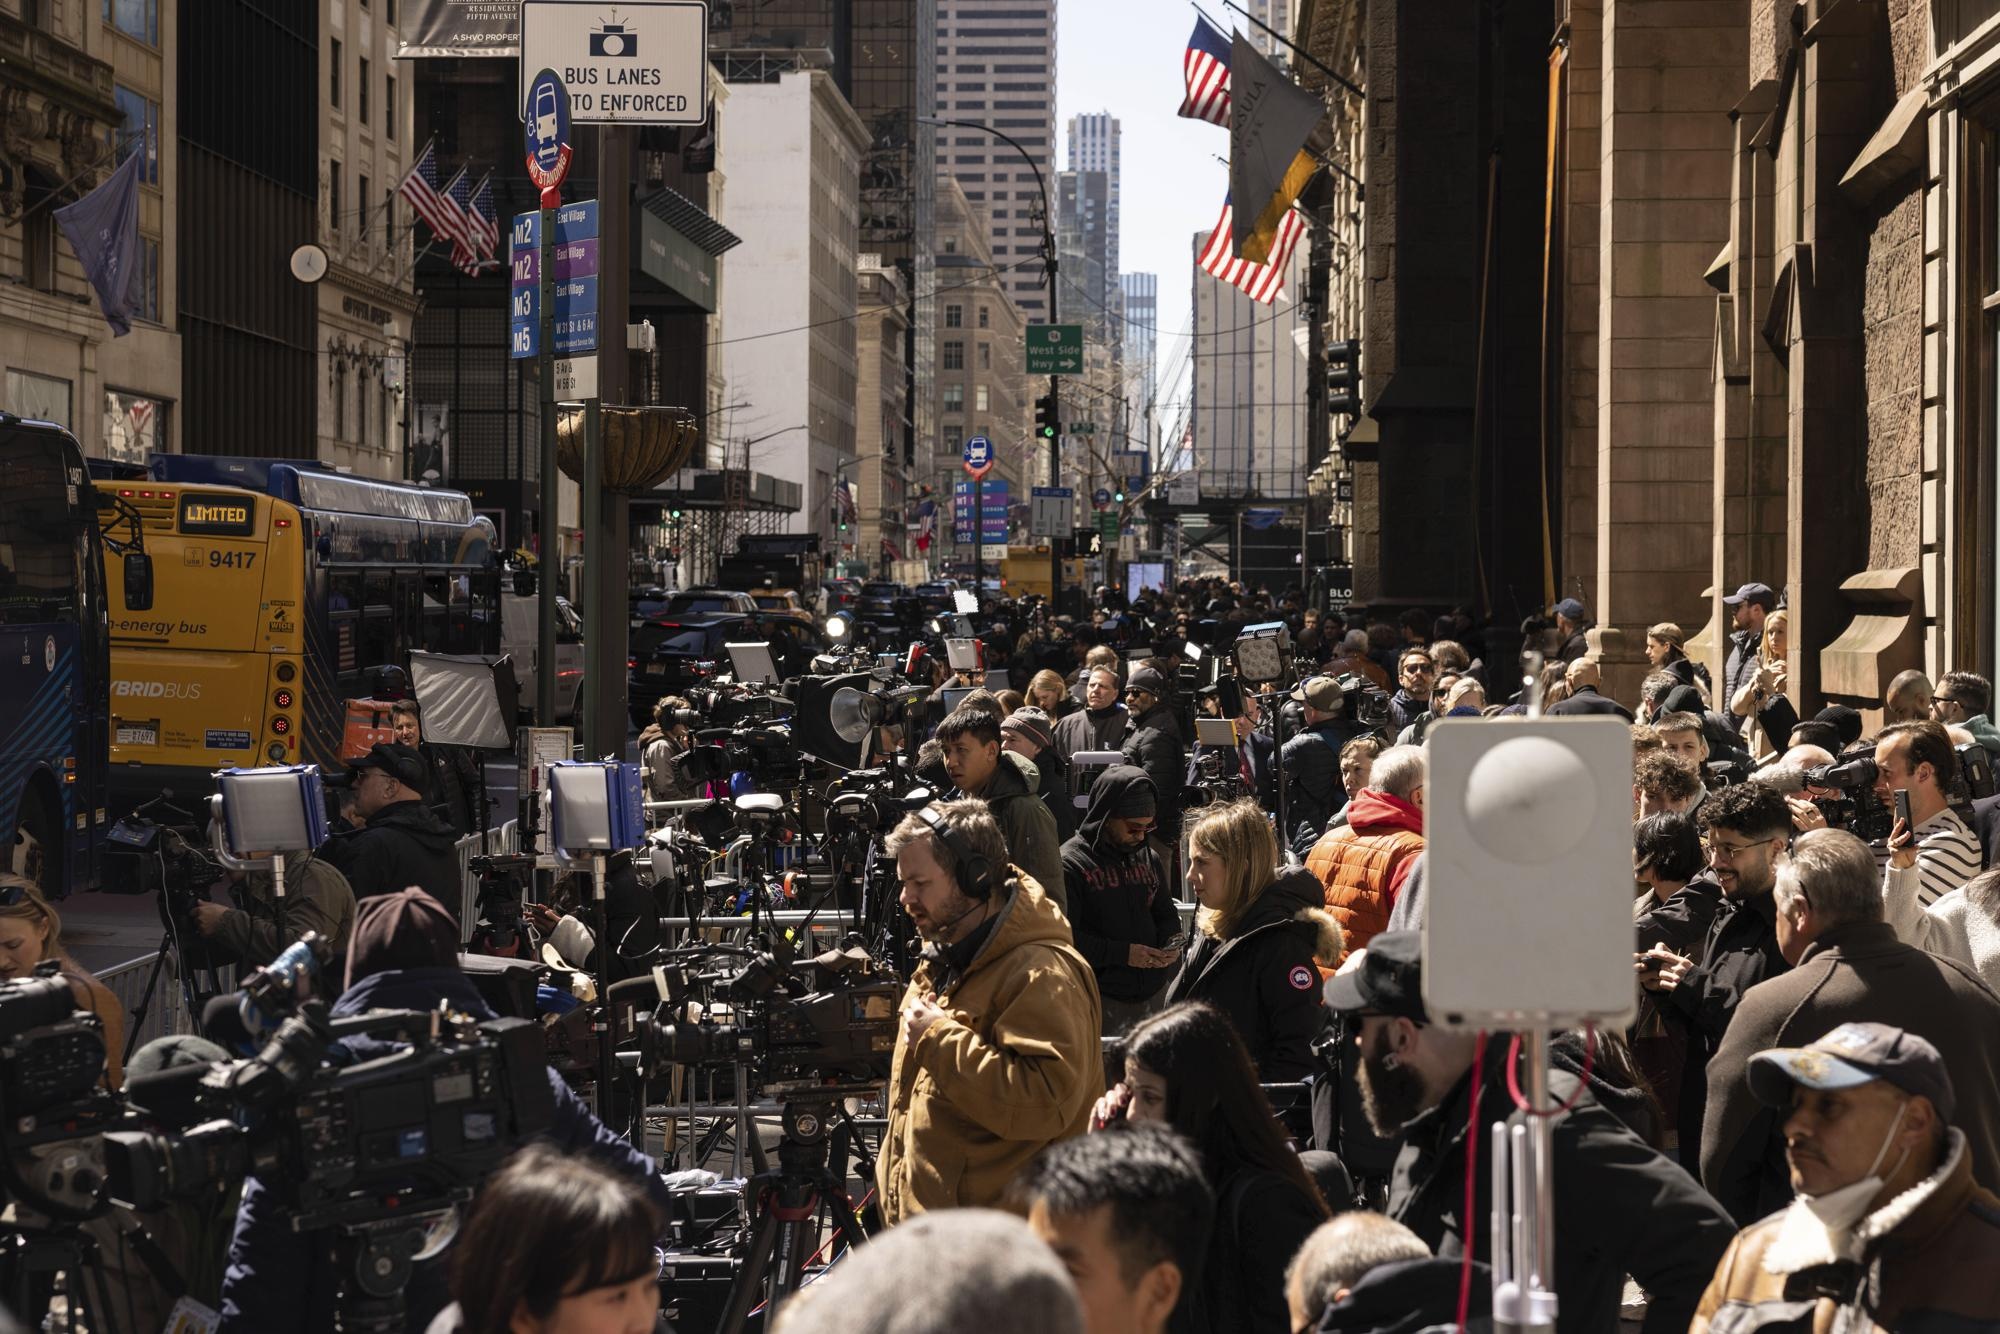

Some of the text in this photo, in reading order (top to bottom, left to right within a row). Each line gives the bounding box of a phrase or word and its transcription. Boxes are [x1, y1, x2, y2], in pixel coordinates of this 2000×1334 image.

[453, 33, 459, 41] A
[460, 33, 483, 41] SHVO
[565, 68, 661, 85] BUS LANES
[600, 94, 687, 112] ENFORCED
[529, 153, 567, 186] NO STANDING
[557, 209, 586, 224] East Village
[515, 218, 532, 245] M2
[556, 246, 586, 261] East Village
[514, 254, 531, 281] M2
[556, 283, 585, 297] East Village
[514, 290, 531, 317] M3
[555, 318, 594, 335] W 31 St & 6 Av
[513, 326, 531, 353] M5
[1029, 345, 1080, 355] West Side
[556, 363, 560, 374] 5
[561, 363, 568, 374] Av
[1031, 360, 1054, 370] Hwy
[556, 378, 561, 390] W
[570, 378, 576, 390] St
[956, 483, 967, 493] M1
[186, 506, 247, 523] LIMITED
[209, 549, 256, 569] 9417
[179, 620, 207, 634] bus
